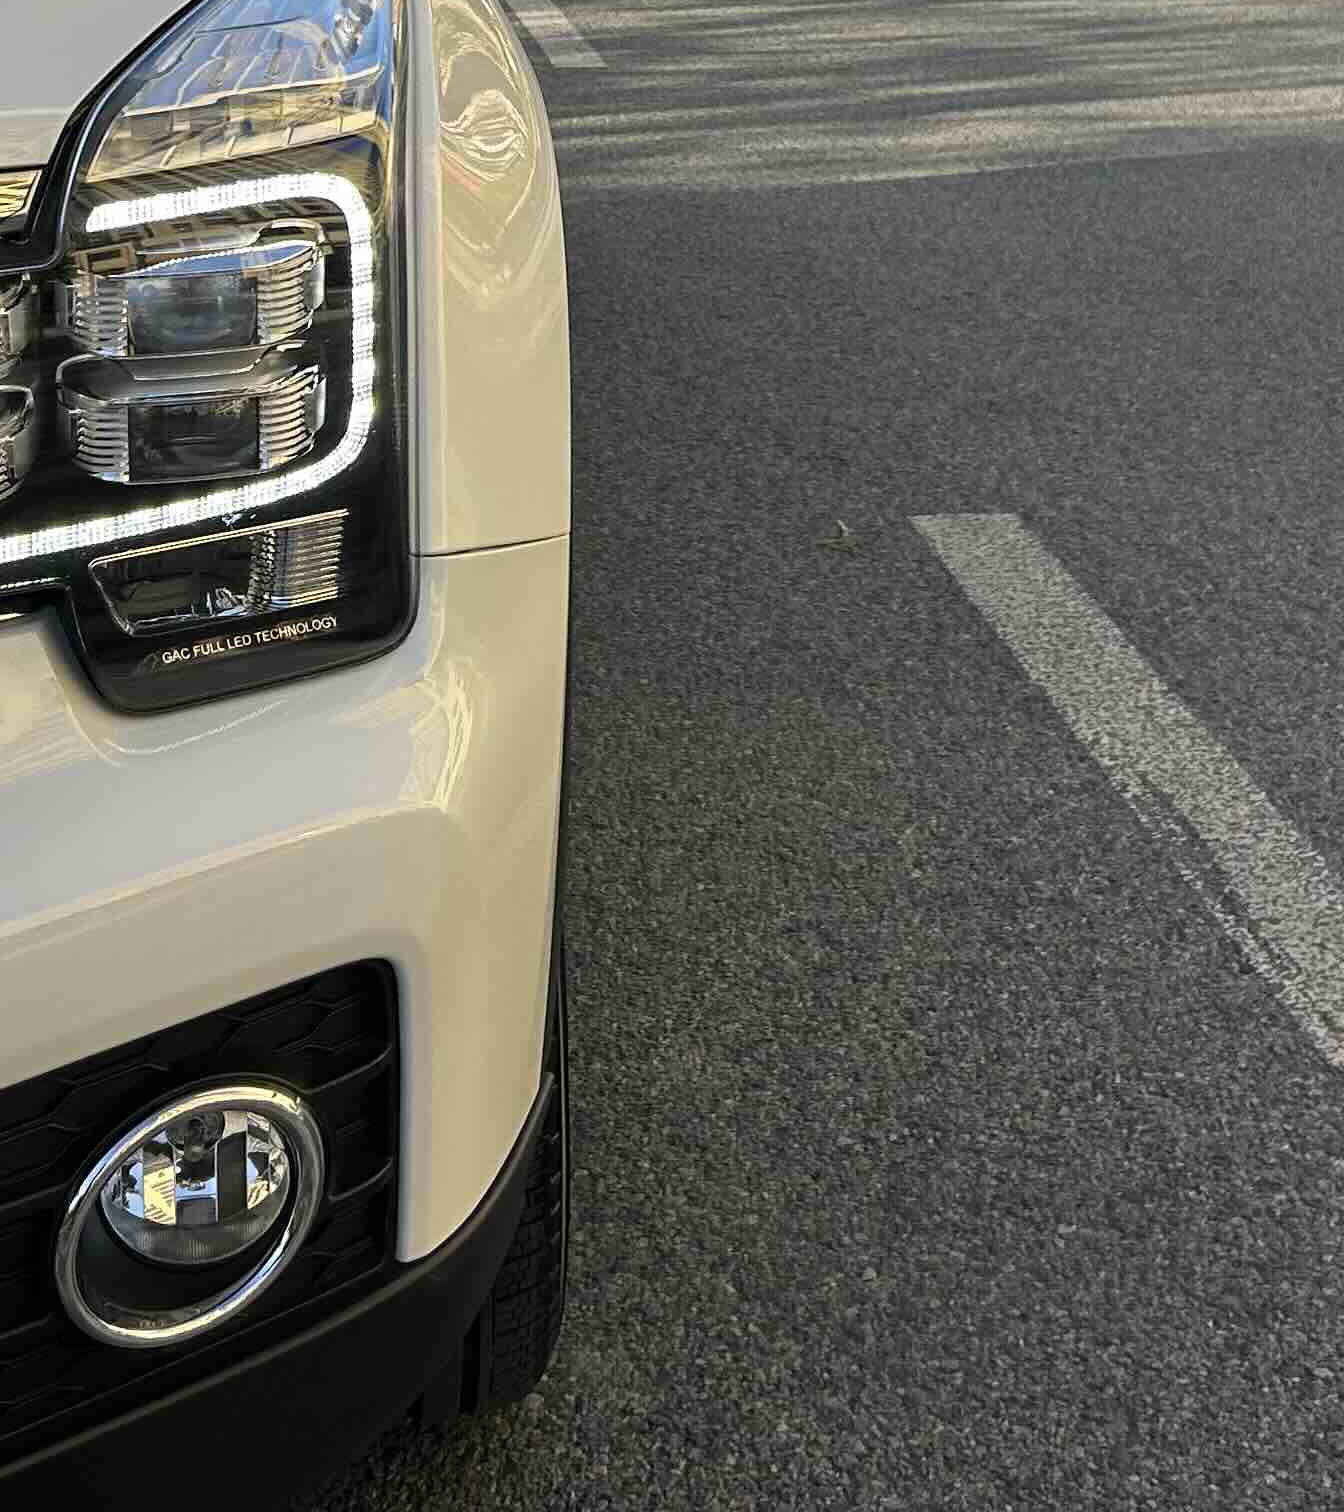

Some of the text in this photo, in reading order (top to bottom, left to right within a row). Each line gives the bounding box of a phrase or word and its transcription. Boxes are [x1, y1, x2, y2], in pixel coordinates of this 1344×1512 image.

[162, 616, 337, 664] GAC FULL LED TECHNOLOGY
